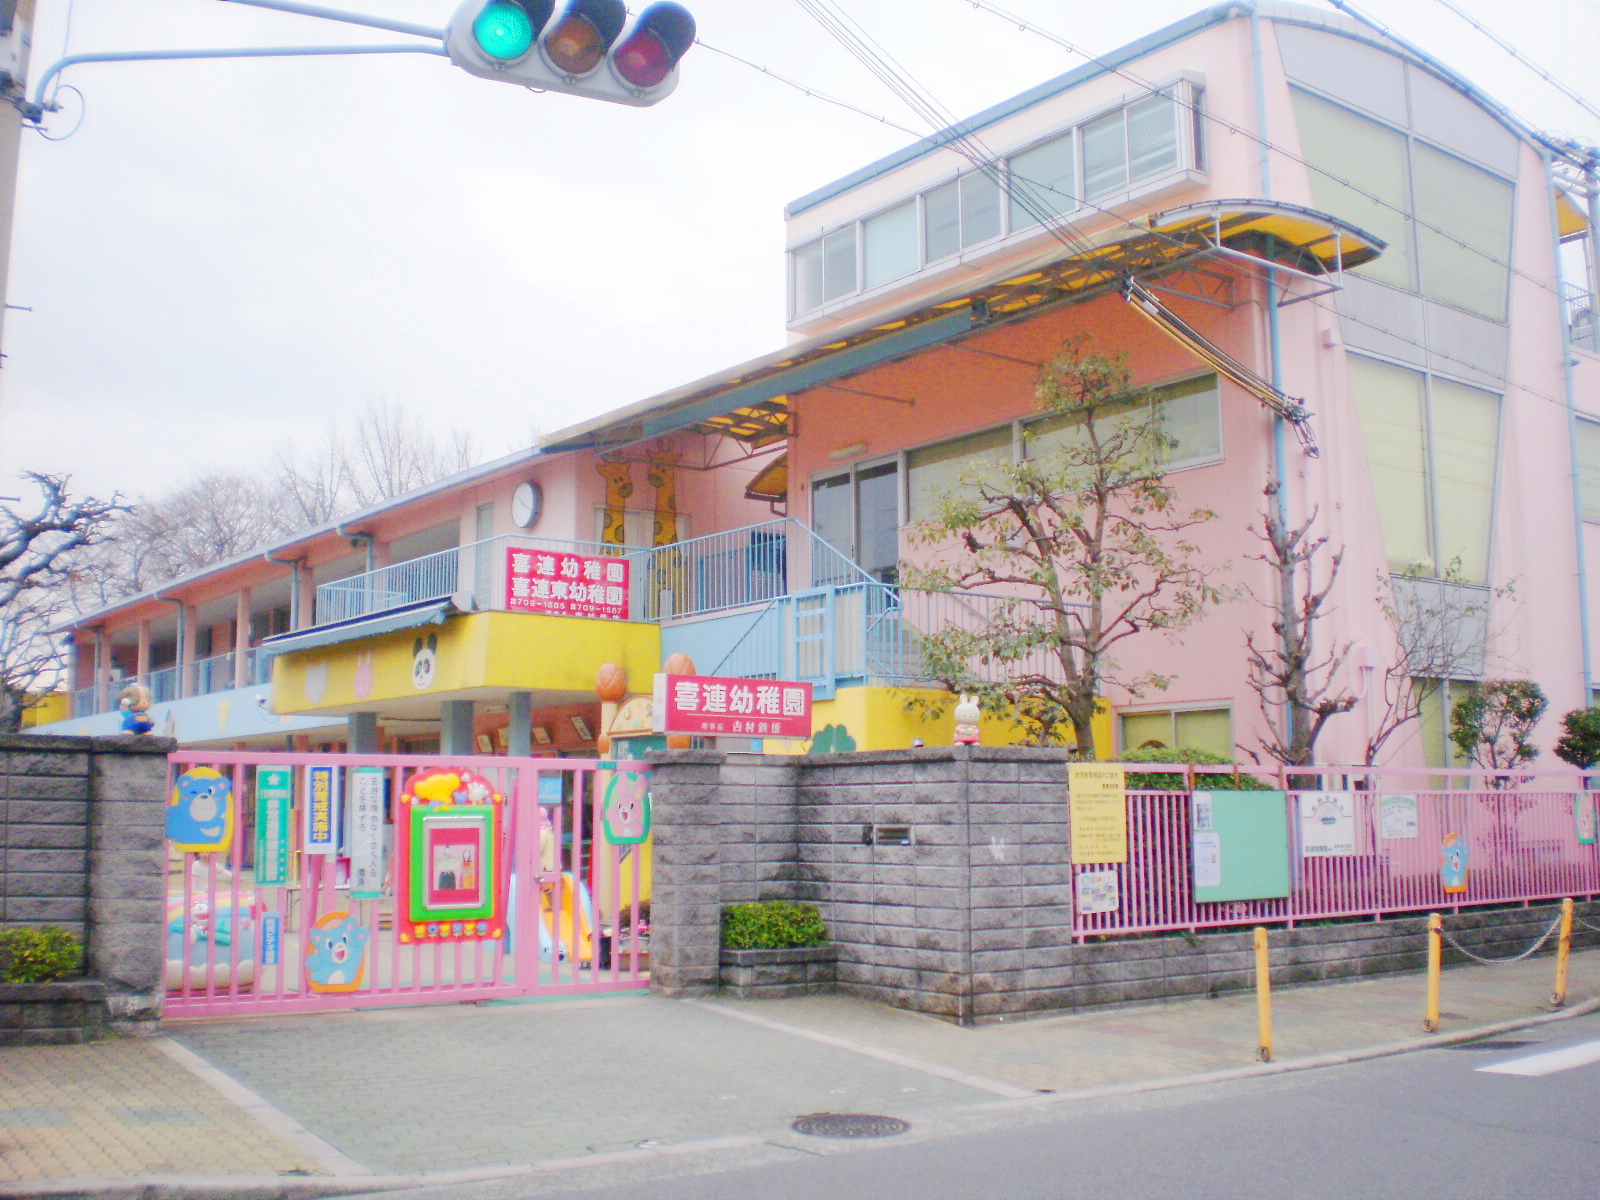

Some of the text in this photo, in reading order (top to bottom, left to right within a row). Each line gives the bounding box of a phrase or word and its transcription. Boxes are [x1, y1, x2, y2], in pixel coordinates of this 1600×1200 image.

[512, 553, 624, 582] 喜連幼稚園
[512, 577, 623, 605] 喜連東幼稚園
[674, 681, 805, 716] 喜連幼稚園
[313, 770, 329, 842] 特別警戒実施中
